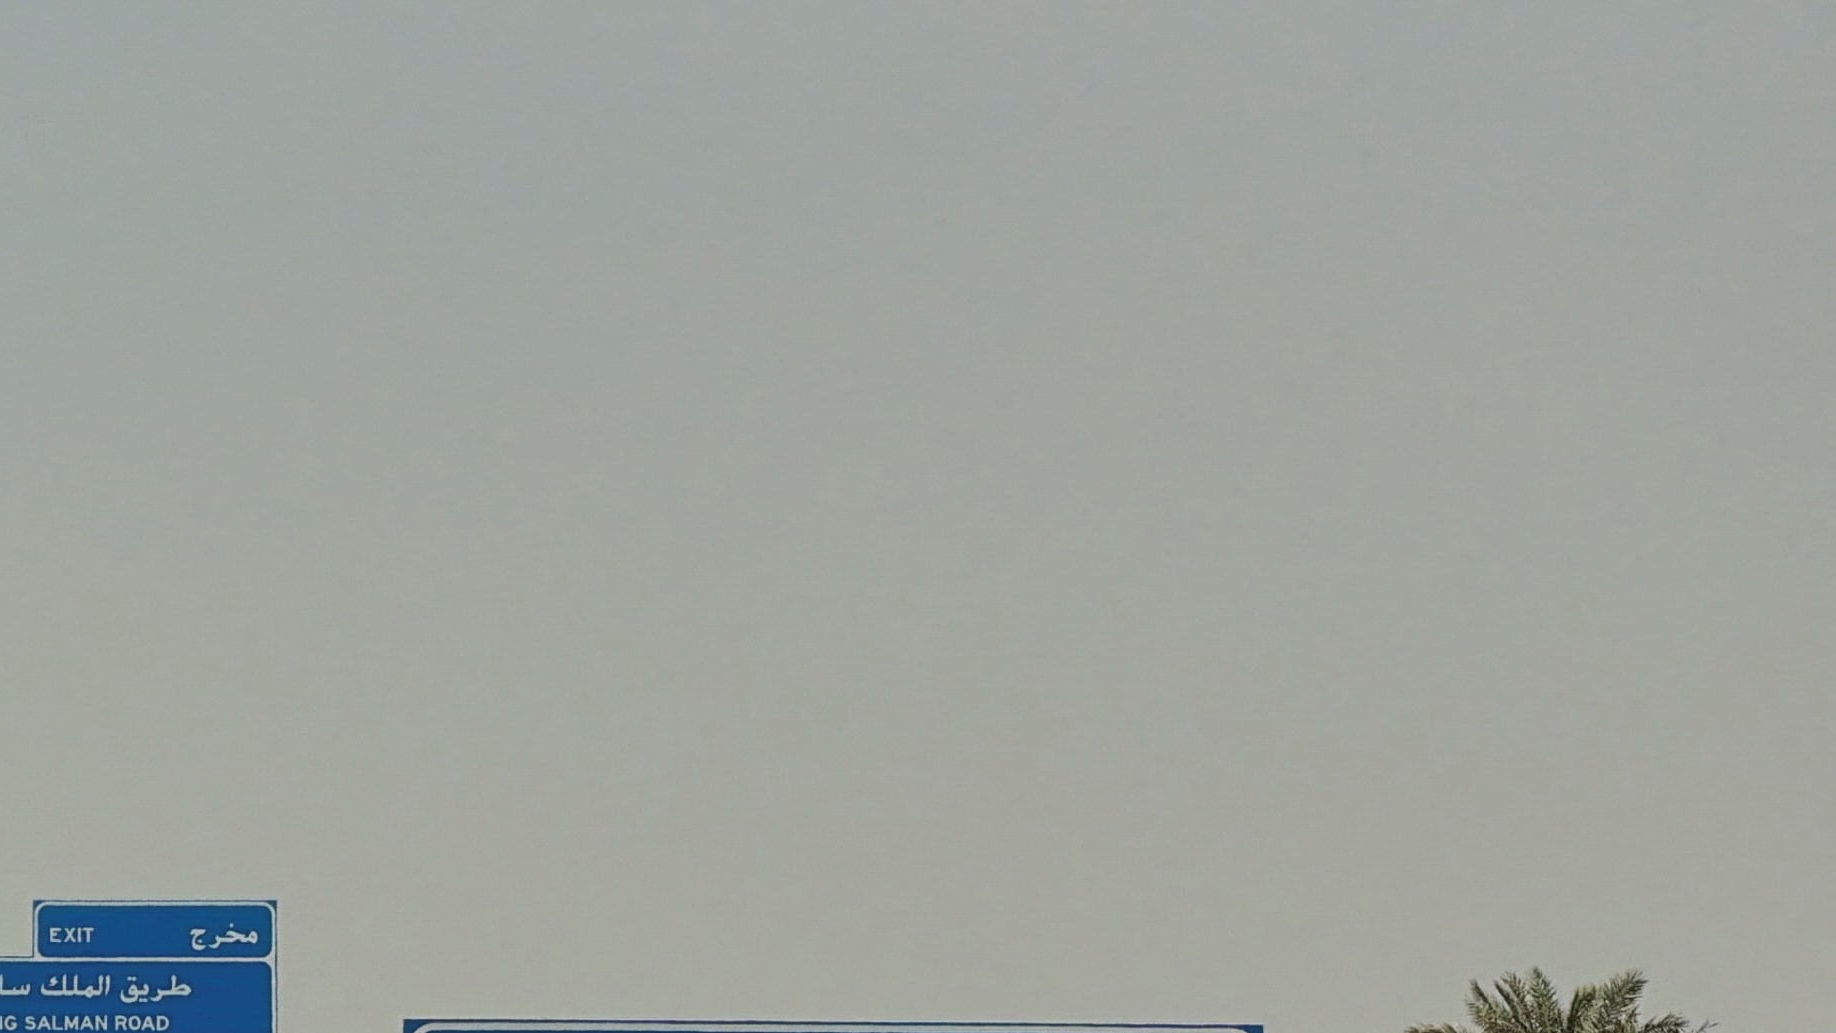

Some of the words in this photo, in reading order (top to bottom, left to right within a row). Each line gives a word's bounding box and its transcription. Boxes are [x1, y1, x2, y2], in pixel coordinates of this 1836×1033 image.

[49, 927, 94, 943] EXIT
[189, 923, 259, 950] مخرج
[40, 974, 111, 999] الملك
[120, 974, 192, 1004] طريق
[24, 1014, 108, 1031] SALMAN
[114, 1014, 170, 1031] ROAD
